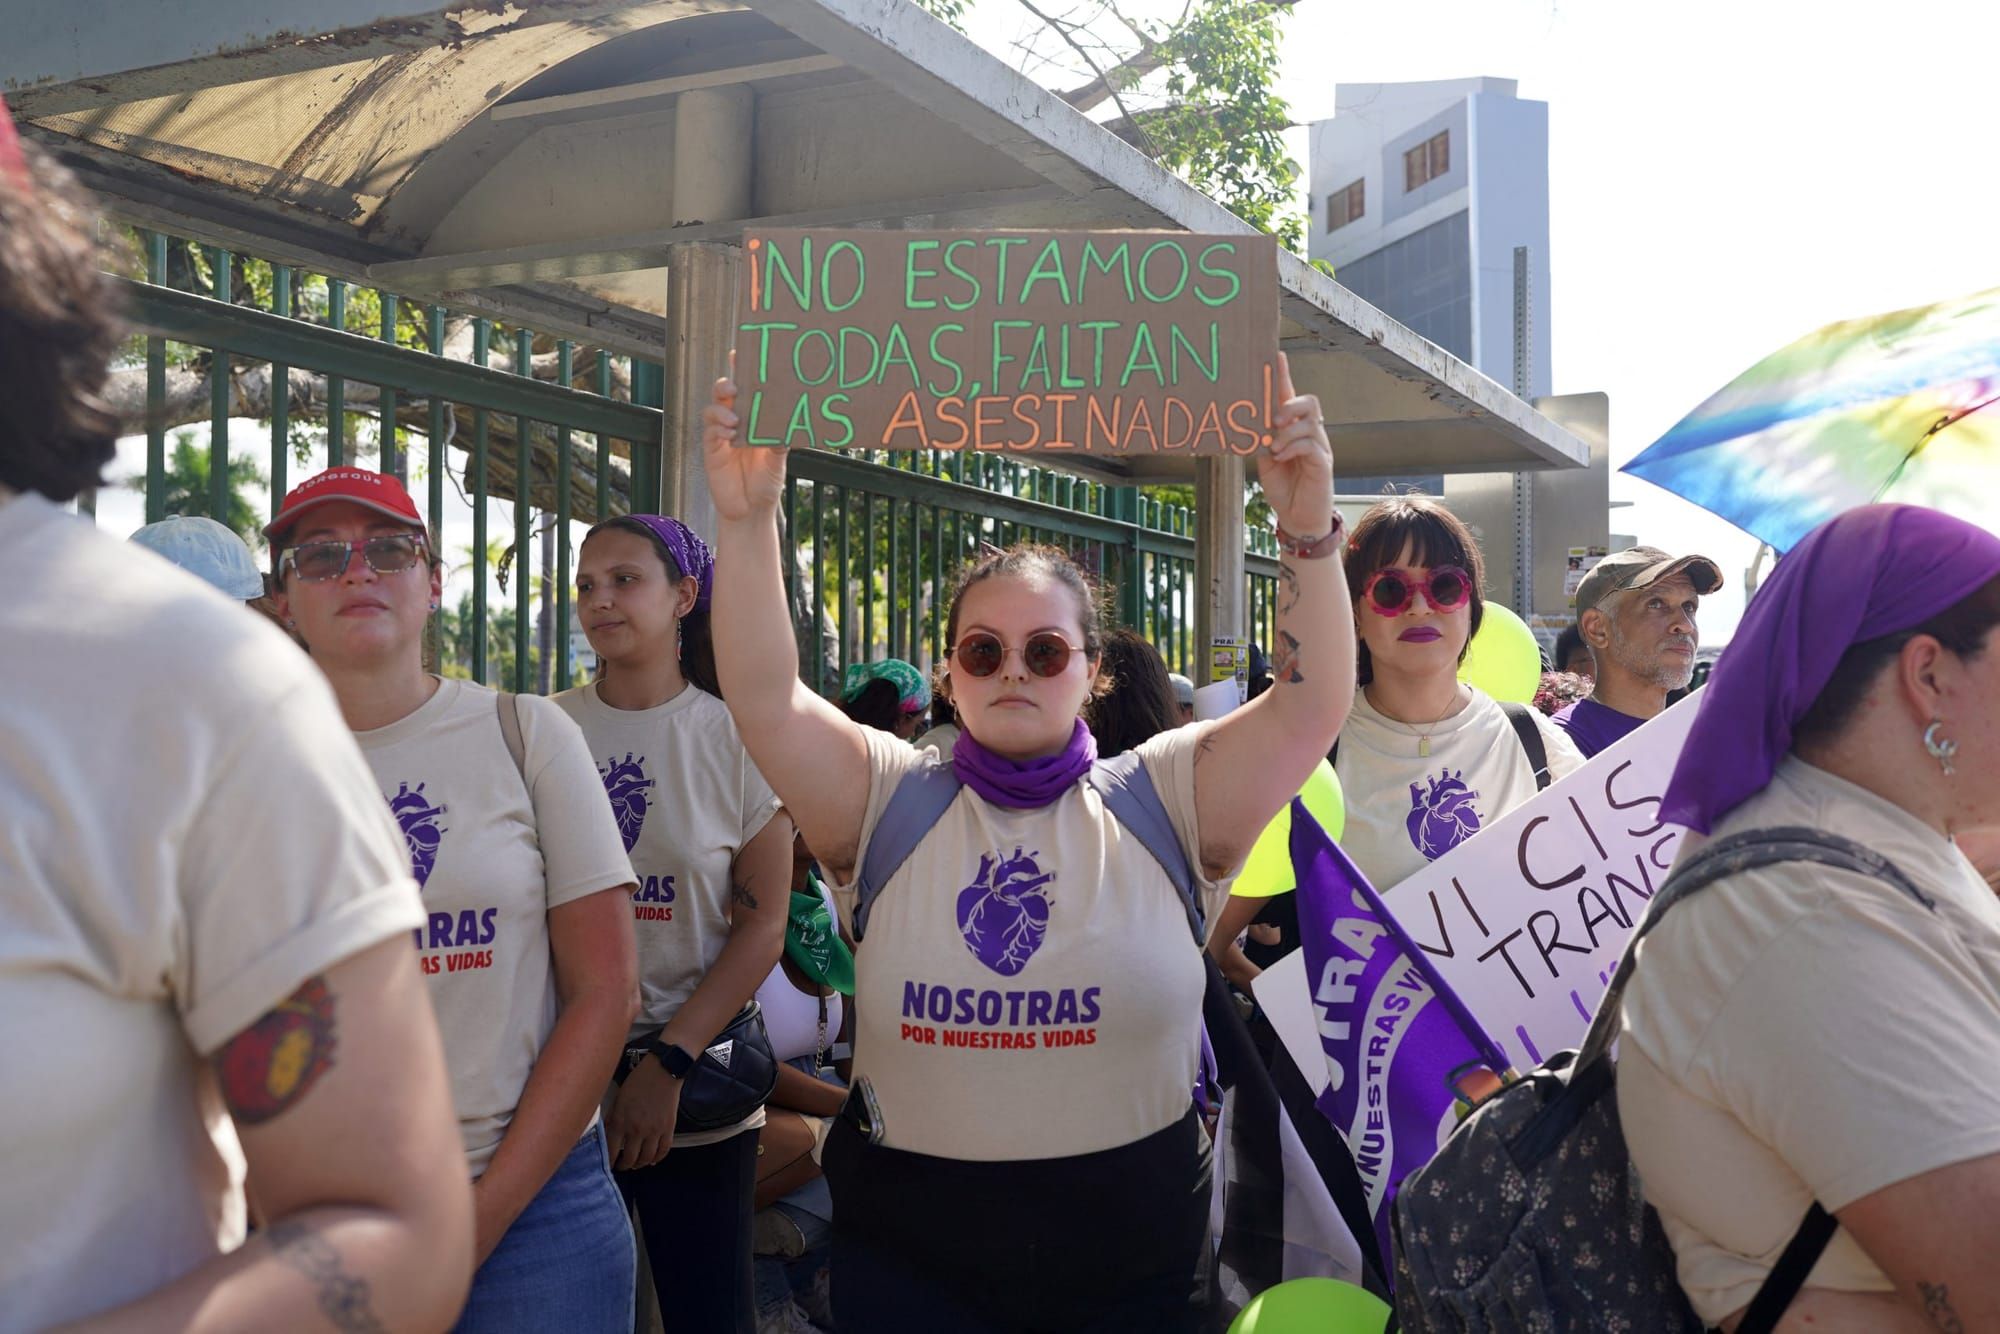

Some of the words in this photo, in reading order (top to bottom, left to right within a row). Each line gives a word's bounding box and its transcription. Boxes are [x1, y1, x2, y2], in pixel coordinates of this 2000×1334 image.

[905, 238, 1241, 306] ESTAMOS
[992, 320, 1220, 391] FALTAN
[748, 391, 854, 447] LAS
[882, 363, 1274, 455] ASESINADAS!
[1517, 760, 1665, 889] CIS
[634, 906, 673, 921] VIDAS
[446, 950, 493, 973] VIDAS
[901, 1023, 936, 1045] POR
[943, 1029, 1036, 1049] NUESTRAS
[1043, 1028, 1096, 1048] VIDAS
[902, 981, 1100, 1026] NOSOTRAS
[1355, 992, 1411, 1177] NUESTRAS
